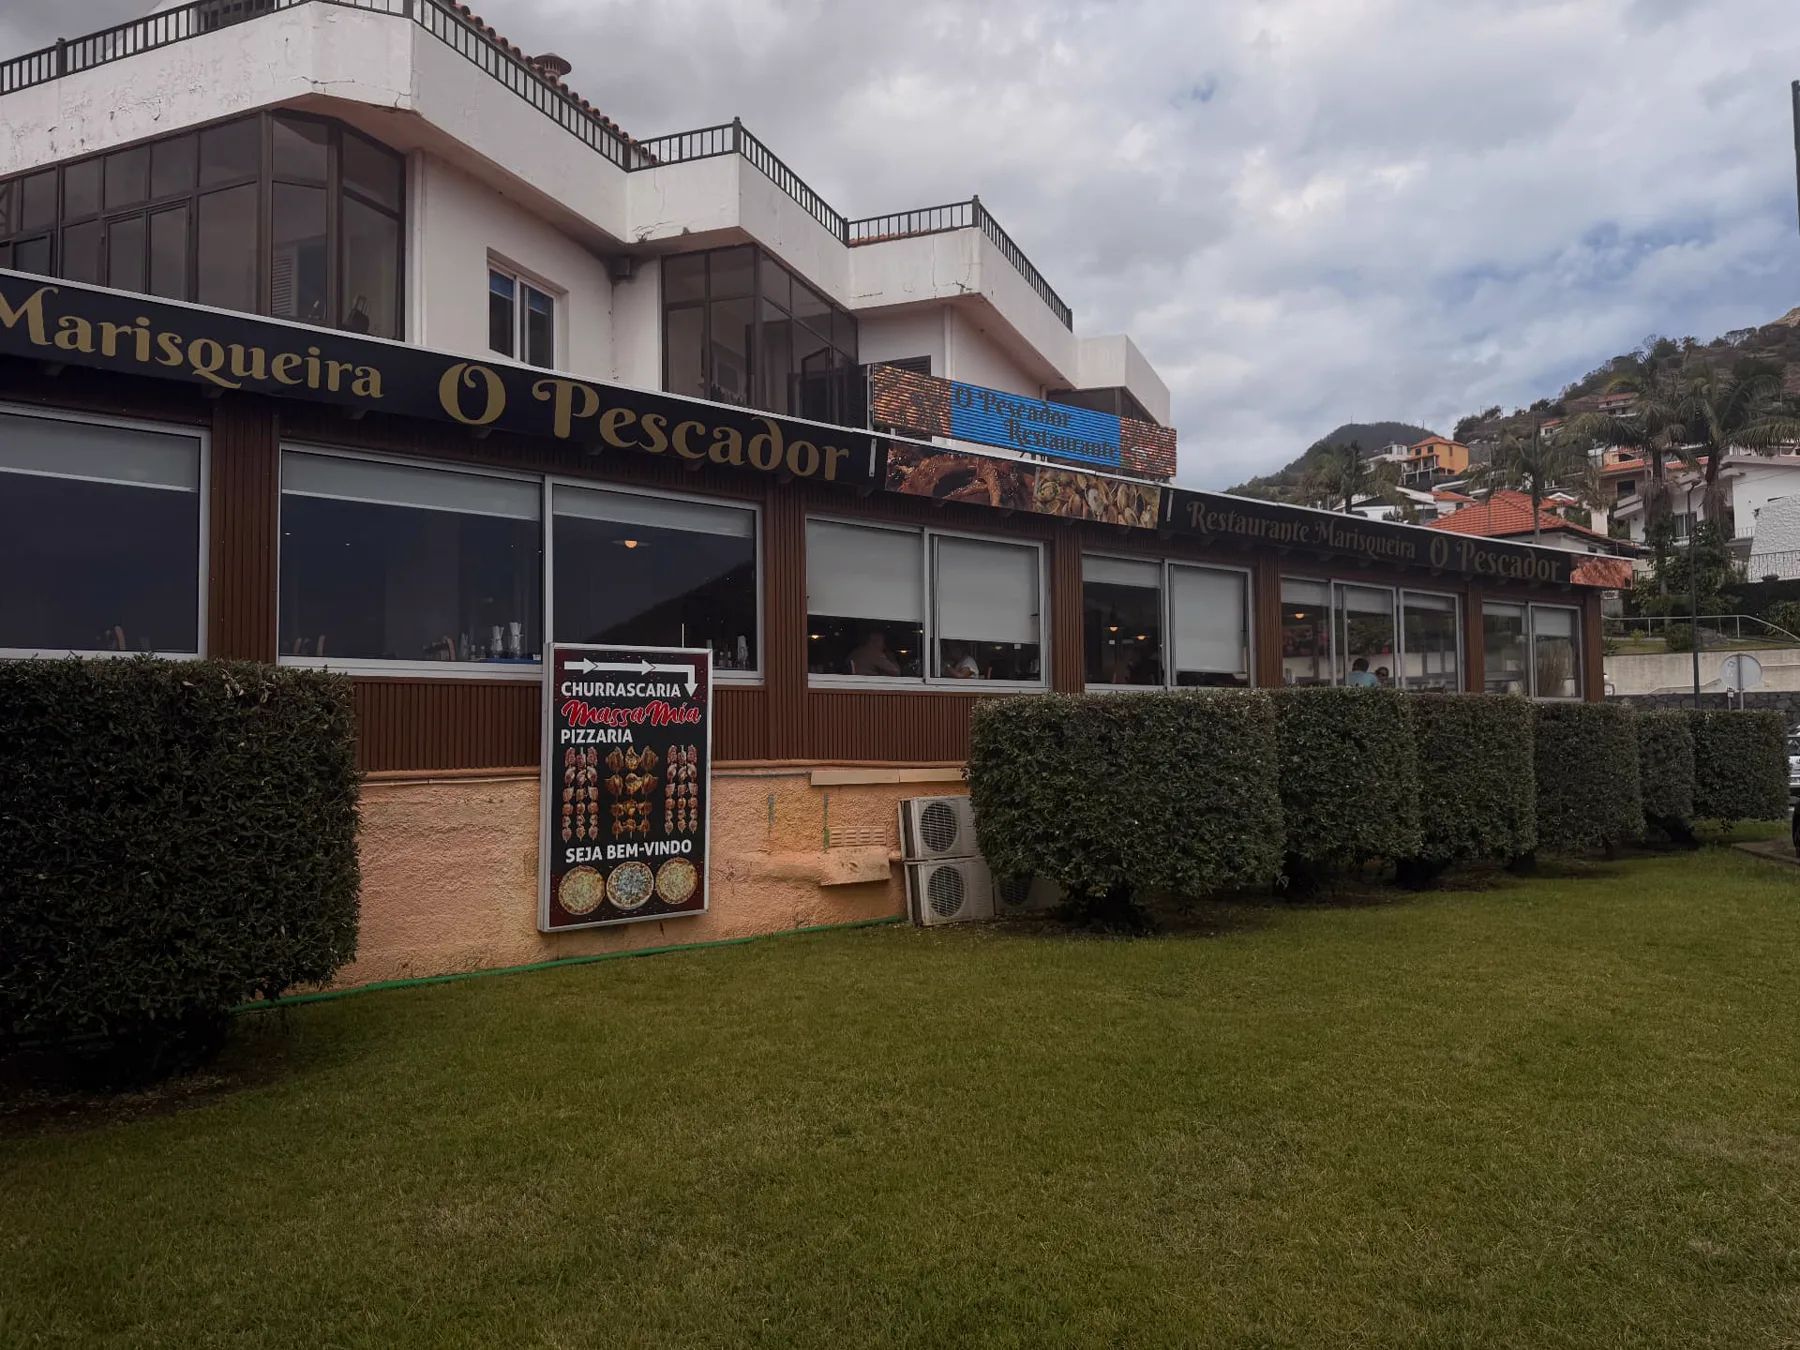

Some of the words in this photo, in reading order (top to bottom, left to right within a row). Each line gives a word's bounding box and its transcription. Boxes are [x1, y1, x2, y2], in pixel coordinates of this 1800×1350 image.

[438, 363, 507, 426] O
[531, 379, 849, 481] Pescador
[1186, 502, 1308, 545] Restaurante
[1312, 523, 1416, 560] Marisqueira
[1430, 536, 1449, 569] O
[1456, 539, 1560, 582] Pescador
[561, 681, 681, 698] CHURRASCARIA
[560, 729, 633, 744] PIZZARIA
[565, 847, 603, 863] SEJA
[606, 839, 692, 859] BEM-VINDO
